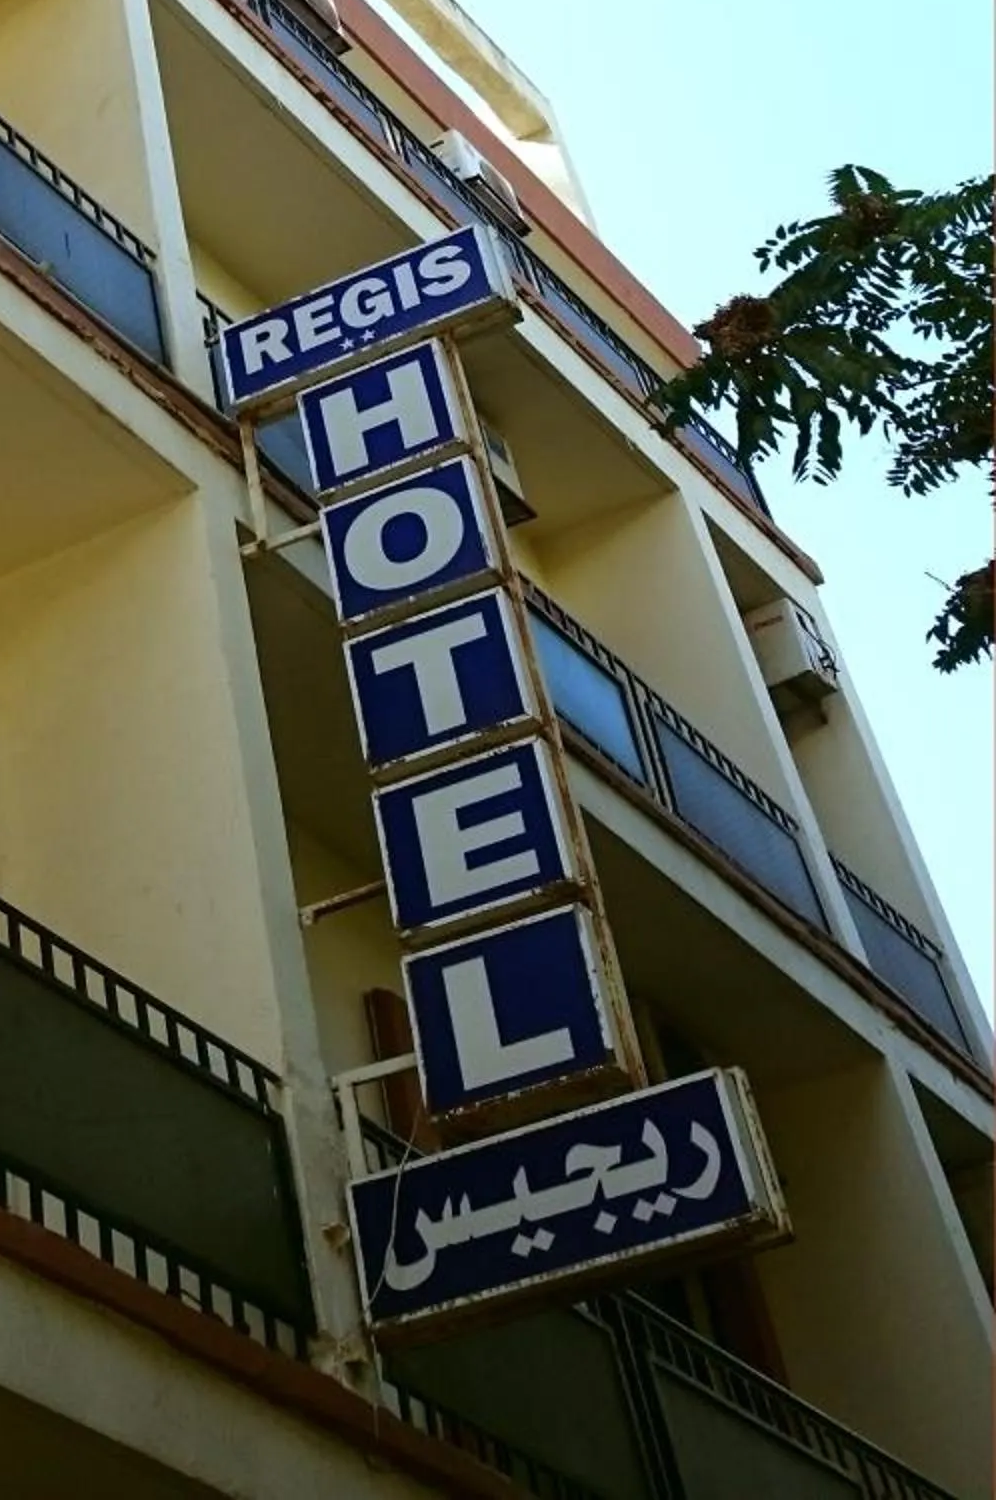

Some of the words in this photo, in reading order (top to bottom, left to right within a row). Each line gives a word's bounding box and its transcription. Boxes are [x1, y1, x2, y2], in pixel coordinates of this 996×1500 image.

[240, 246, 471, 374] REGIS
[318, 361, 575, 1090] HOTEL
[386, 1118, 721, 1292] ريجيس
